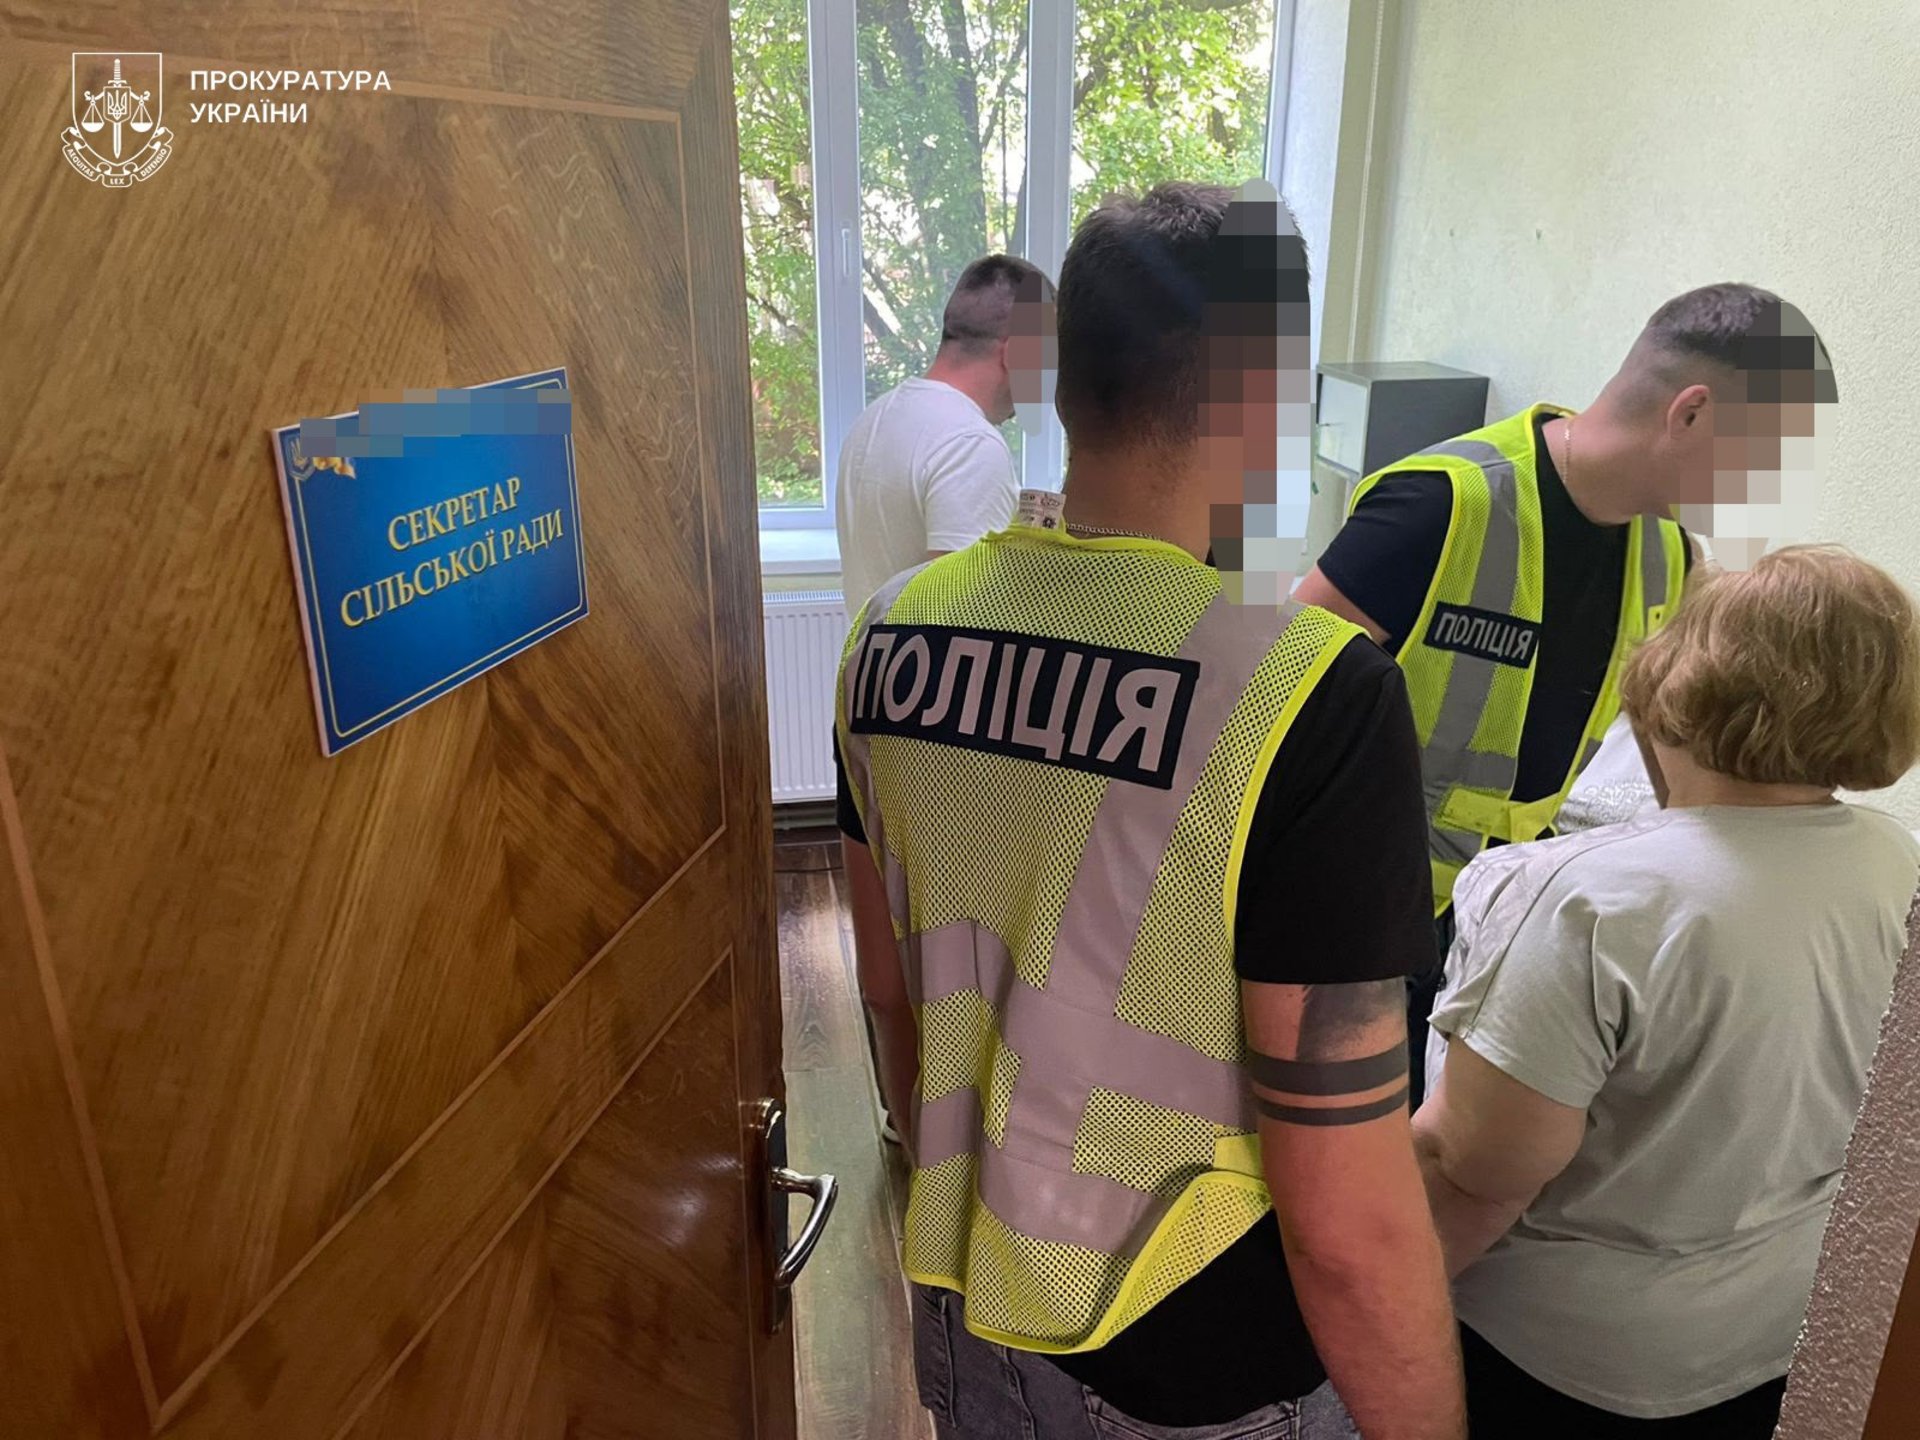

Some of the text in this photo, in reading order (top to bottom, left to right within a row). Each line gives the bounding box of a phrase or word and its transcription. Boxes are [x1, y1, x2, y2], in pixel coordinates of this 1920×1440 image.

[387, 476, 521, 551] СЕКРЕТАР
[340, 509, 563, 628] СІЛЬСЬКОЇ РАДИ
[1434, 612, 1533, 660] ПОЛІЦІЯ
[855, 632, 1181, 773] ПОЛІЦІЯ
